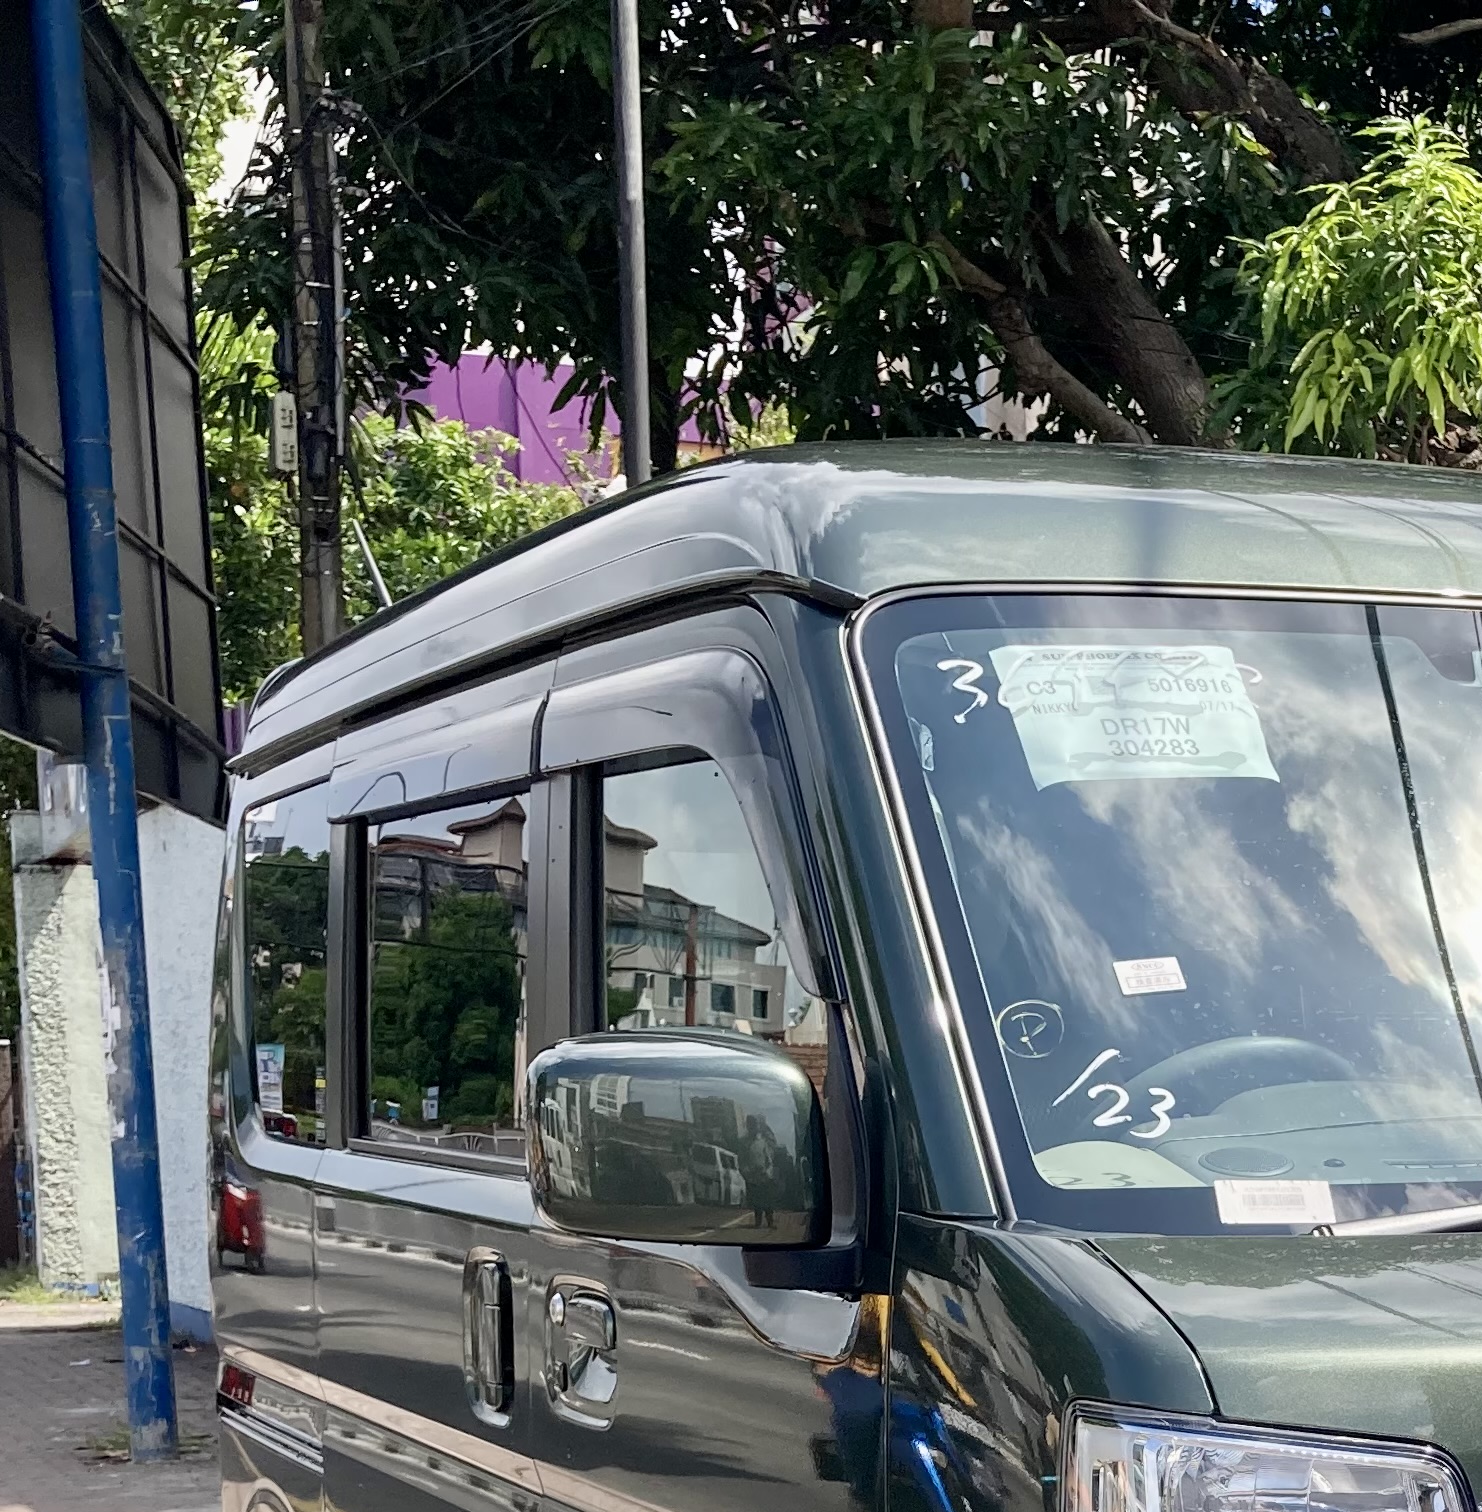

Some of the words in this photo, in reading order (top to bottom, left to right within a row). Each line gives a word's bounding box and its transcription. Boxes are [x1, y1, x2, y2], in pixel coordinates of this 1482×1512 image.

[1147, 677, 1233, 695] 5016916
[1100, 717, 1191, 736] DR17W
[1109, 740, 1201, 757] 304283
